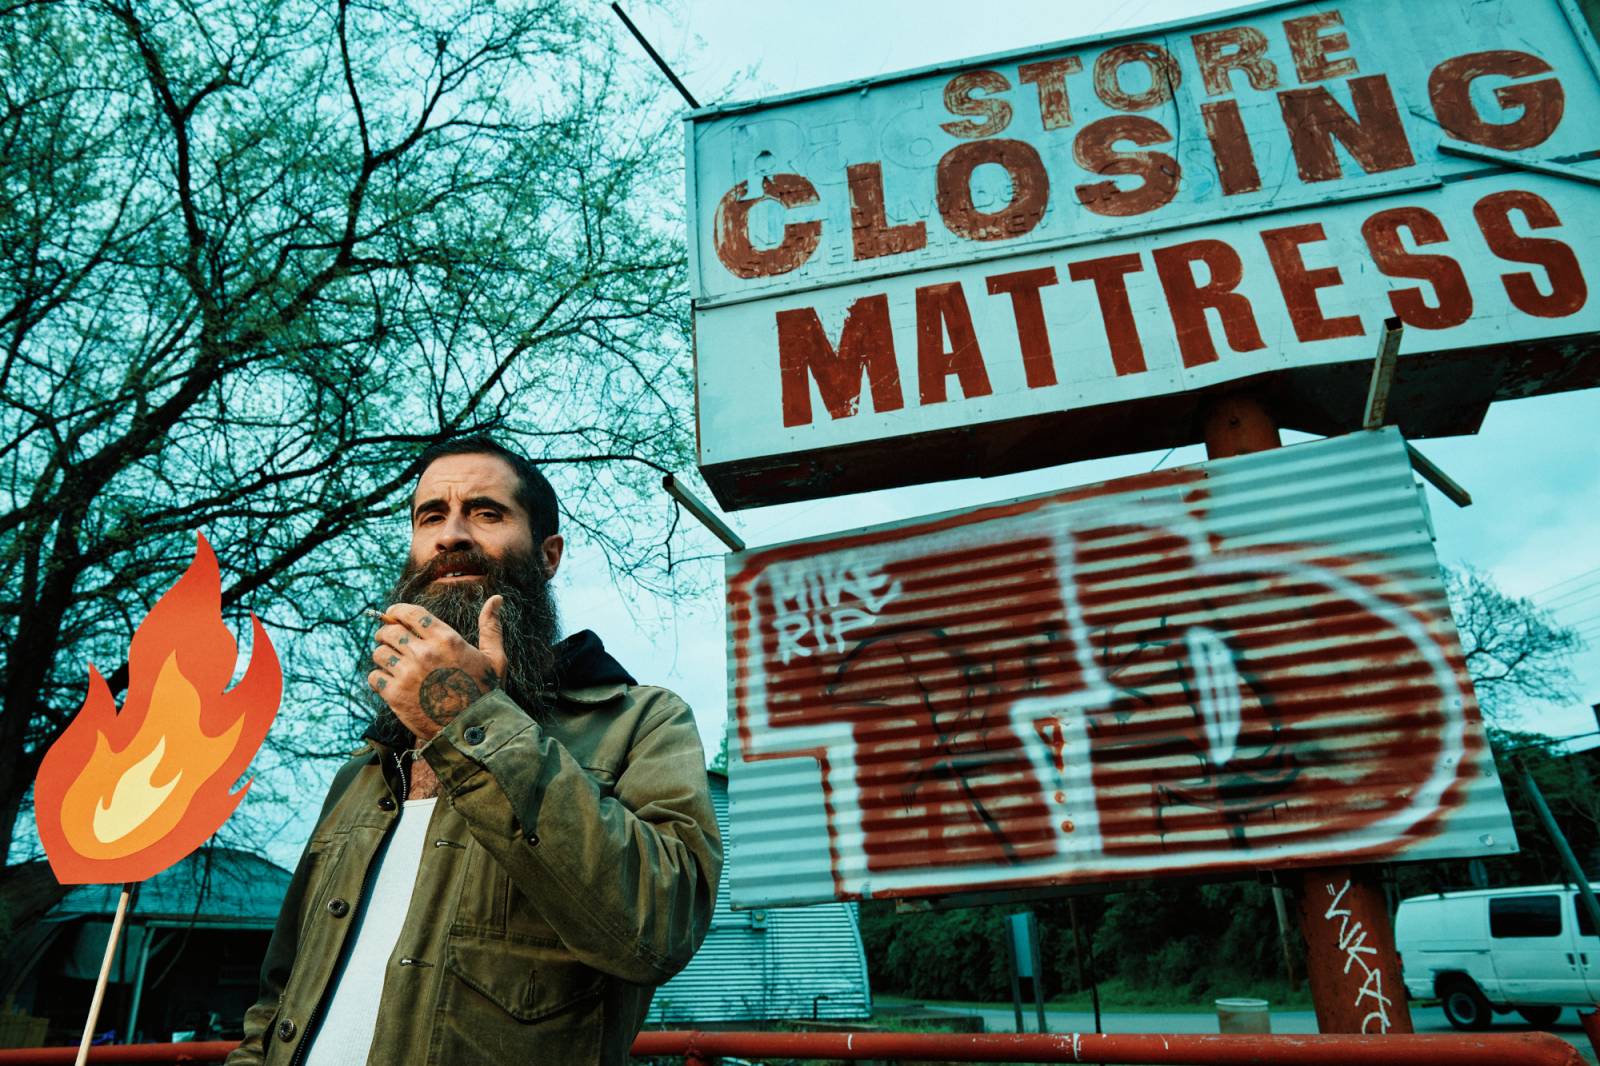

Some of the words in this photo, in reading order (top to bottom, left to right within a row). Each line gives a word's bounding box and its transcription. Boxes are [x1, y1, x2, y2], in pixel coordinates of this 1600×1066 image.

[714, 49, 1566, 279] CLOSING
[940, 10, 1359, 139] STORE
[775, 189, 1589, 428] MATTRESS
[772, 608, 876, 666] RIP
